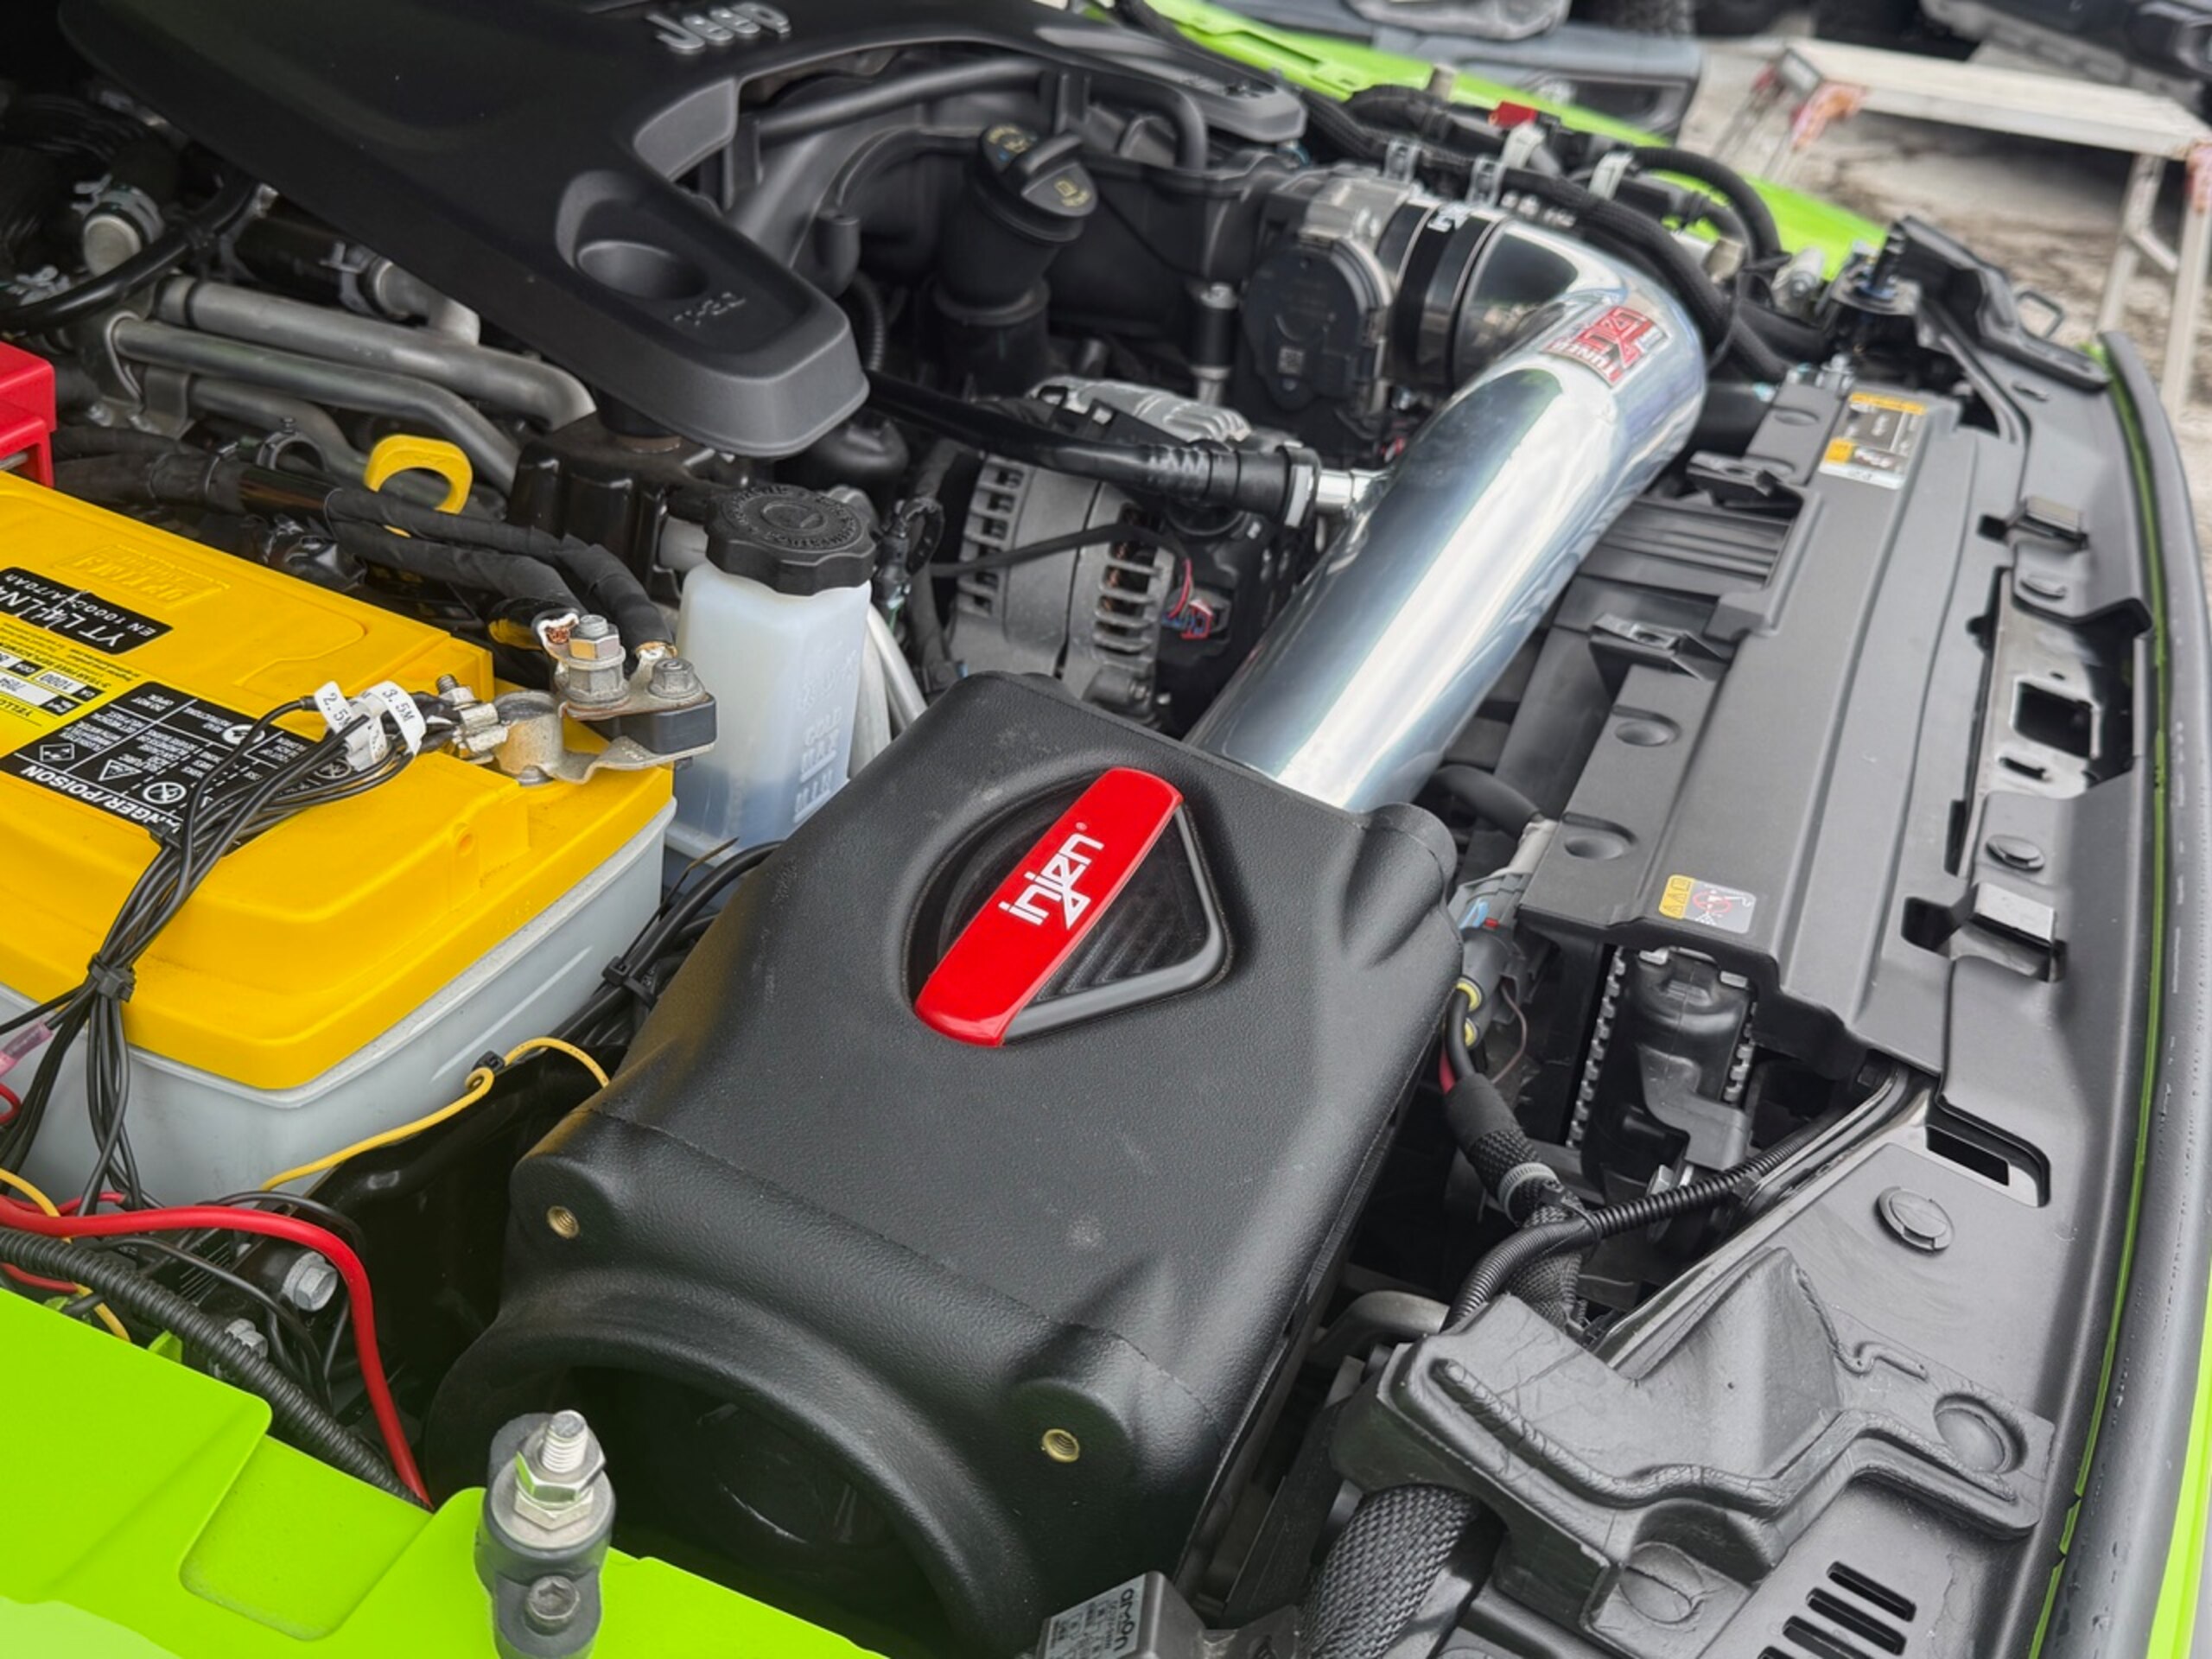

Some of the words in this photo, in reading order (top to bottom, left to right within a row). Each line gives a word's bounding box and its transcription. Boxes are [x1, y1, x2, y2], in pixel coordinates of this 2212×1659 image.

[645, 3, 791, 50] Jeep
[127, 621, 156, 637] EN
[800, 728, 841, 775] MAX
[794, 769, 833, 813] MIN
[998, 831, 1104, 931] injen
